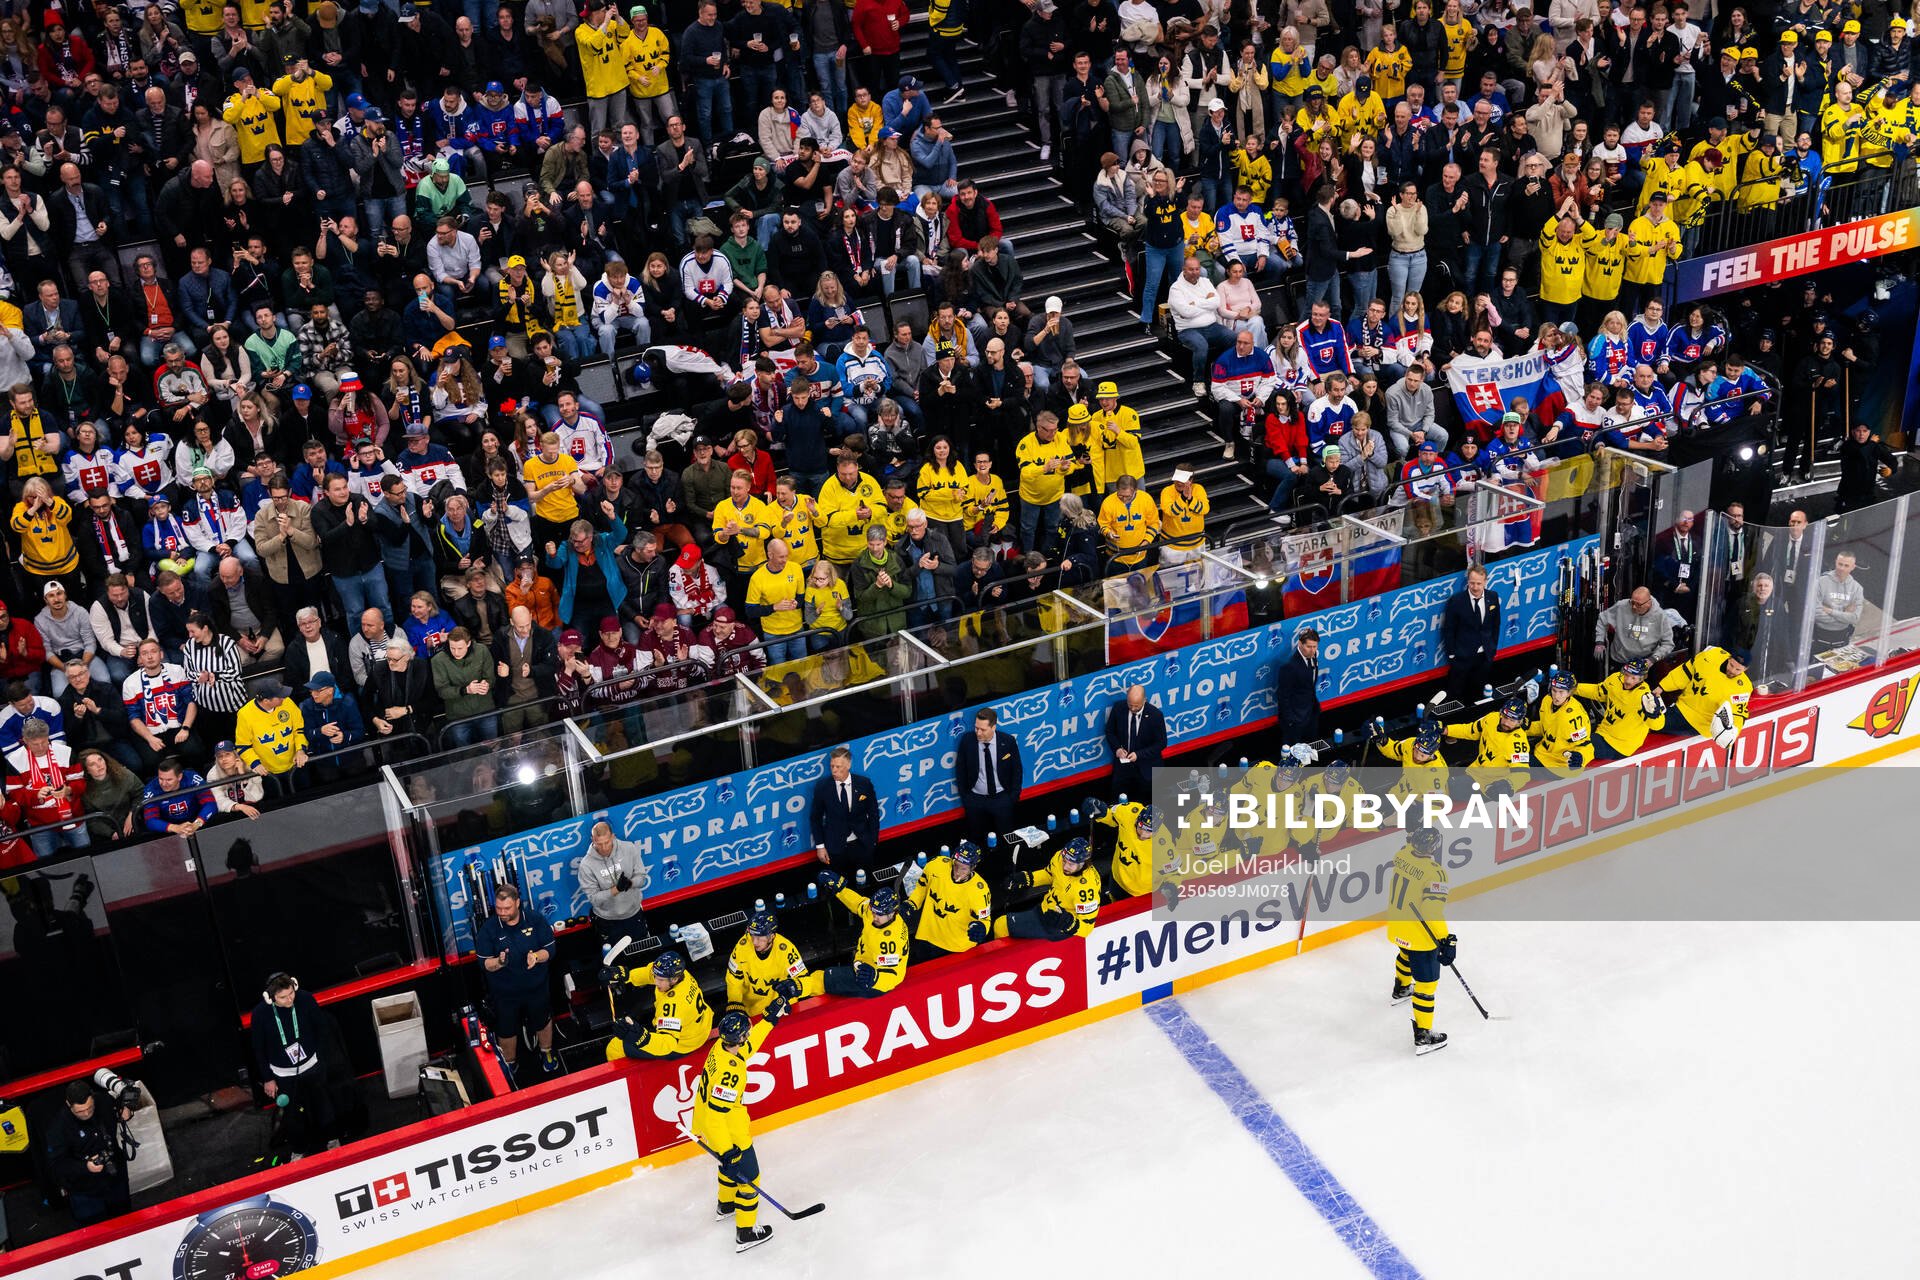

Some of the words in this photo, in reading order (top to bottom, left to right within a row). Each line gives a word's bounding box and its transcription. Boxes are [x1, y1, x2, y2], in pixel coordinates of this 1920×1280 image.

[1702, 252, 1762, 292] FEEL
[1770, 237, 1822, 275] THE
[1829, 217, 1910, 261] PULSE
[1462, 355, 1548, 384] TERCHOV
[1603, 416, 1614, 428] 27
[1324, 627, 1393, 661] ORTS
[990, 689, 1052, 727] LYRS
[1061, 670, 1238, 737] HYATION
[1569, 716, 1584, 730] 77
[1513, 741, 1528, 753] 56
[1433, 778, 1441, 790] 6
[1503, 715, 1809, 848] BAUHAUS
[634, 794, 806, 856] HYDRATIO
[1194, 833, 1211, 844] 82
[1167, 849, 1175, 860] 9
[1436, 870, 1446, 882] 11
[1079, 889, 1095, 903] 93
[1391, 872, 1410, 911] 11
[1097, 833, 1473, 985] #MensWors
[880, 941, 897, 955] 90
[662, 1003, 677, 1017] 91
[744, 957, 1066, 1106] STRAUSS
[720, 1071, 739, 1089] 29
[415, 1106, 608, 1190] TISSOT
[342, 1208, 400, 1234] SWISS
[411, 1176, 498, 1211] WATCHES
[509, 1154, 563, 1179] SINCE
[574, 1138, 614, 1158] 1853
[290, 1209, 303, 1220] 10
[226, 1232, 257, 1247] TISSOT
[176, 1243, 188, 1259] 50
[302, 1254, 314, 1269] 20
